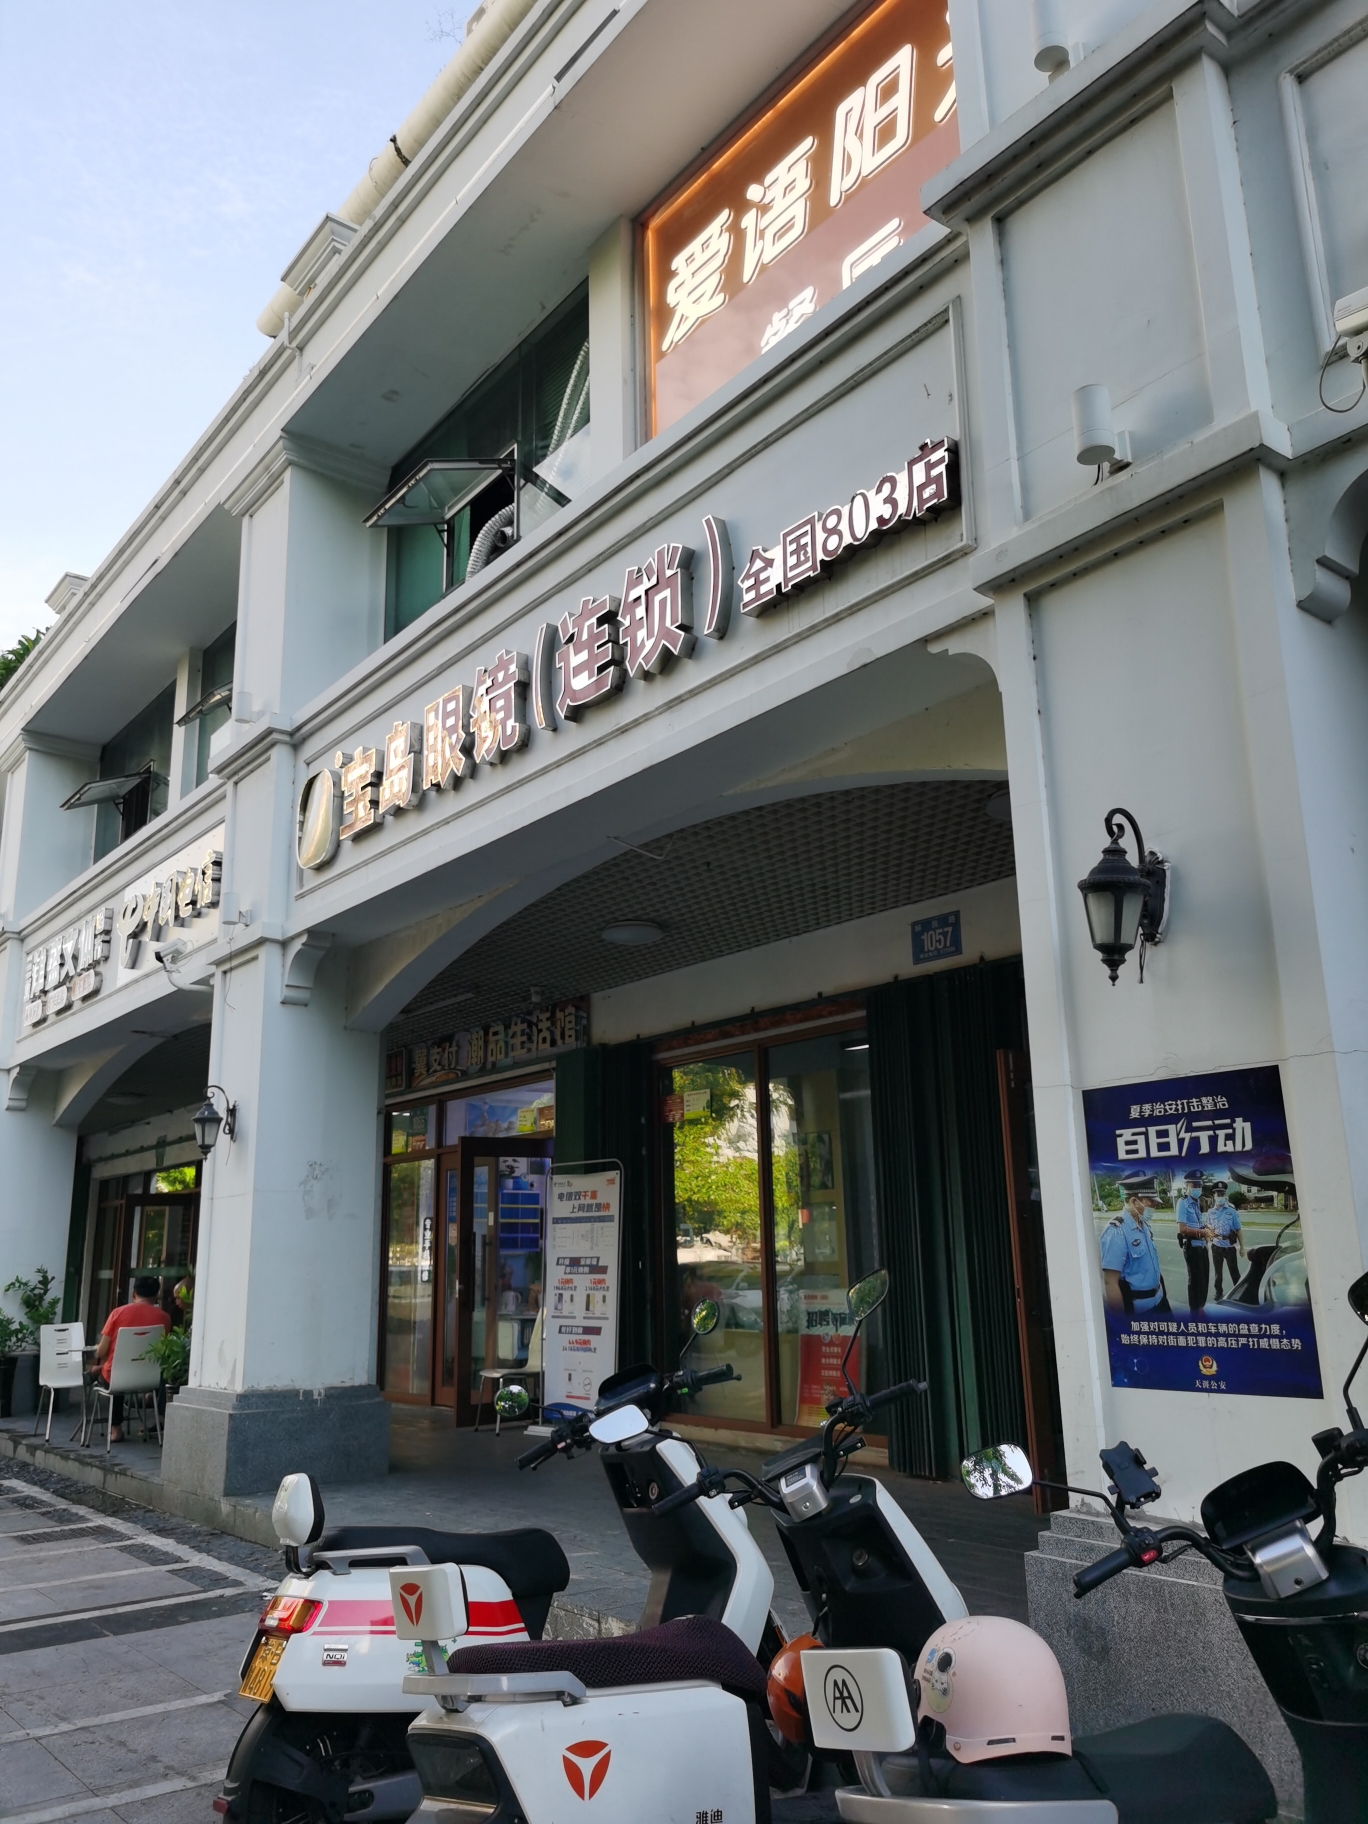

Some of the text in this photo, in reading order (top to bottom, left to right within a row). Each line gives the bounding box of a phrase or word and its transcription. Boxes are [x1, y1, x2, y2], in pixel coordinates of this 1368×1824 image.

[661, 10, 957, 353] 爱语阳
[738, 436, 955, 615] 全国803店
[921, 926, 953, 952] 1057
[468, 1005, 576, 1067] 潮品生活馆
[1129, 1095, 1229, 1119] 夏季治安打击整治
[1115, 1117, 1253, 1160] 百日行动
[1131, 1321, 1286, 1336] 加强对可疑人员和车辆的盘查力度，
[1121, 1334, 1302, 1350] 始终保持对街面犯罪的高压严打威慑态势
[695, 1808, 723, 1824] 雅迪
